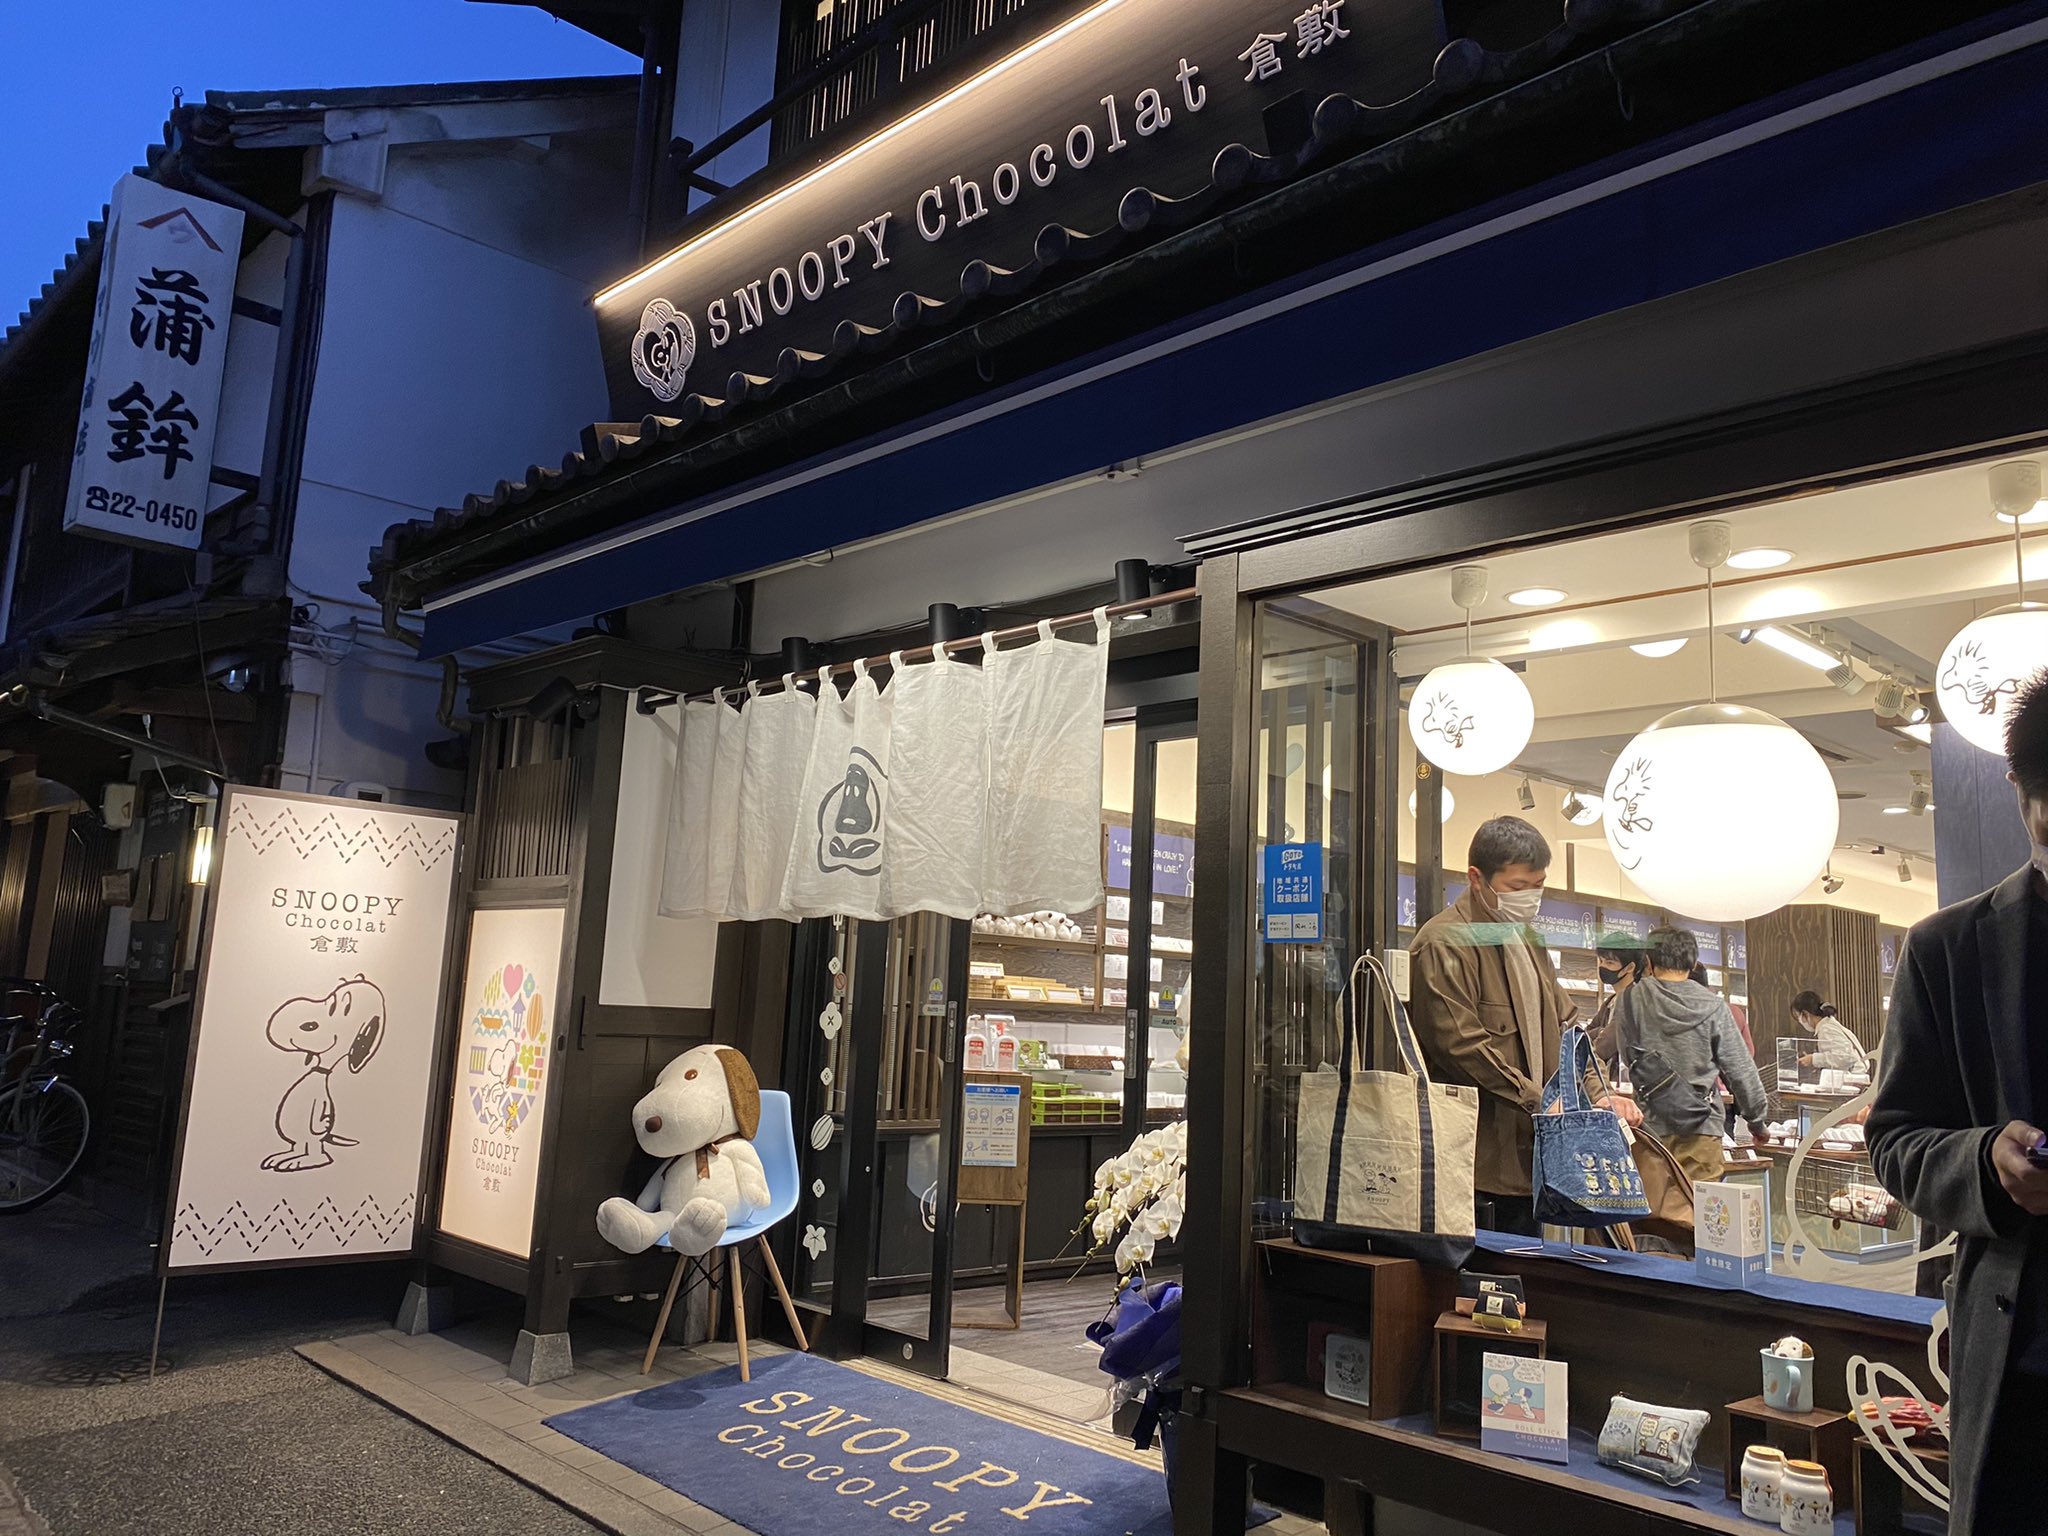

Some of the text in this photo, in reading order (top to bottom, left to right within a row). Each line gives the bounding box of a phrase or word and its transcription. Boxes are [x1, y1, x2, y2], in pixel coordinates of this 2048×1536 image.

[707, 0, 1350, 349] SNOOPY Chocolat 倉敷
[107, 266, 216, 480] 蒲鉾
[1276, 884, 1309, 894] クーポン
[1276, 893, 1309, 904] 取扱店舗
[271, 887, 404, 916] SNOOPY
[284, 912, 387, 933] Chocolat
[309, 935, 359, 954] 倉敷
[471, 1137, 521, 1164] SNOOPY
[474, 1157, 513, 1177] Chocolat
[482, 1176, 502, 1193] 倉敷
[1514, 1433, 1561, 1446] CHOCOLAT
[1515, 1424, 1561, 1436] ROLL STICK
[739, 1389, 1093, 1521] SNOOPY
[716, 1424, 968, 1535] Chocolat
